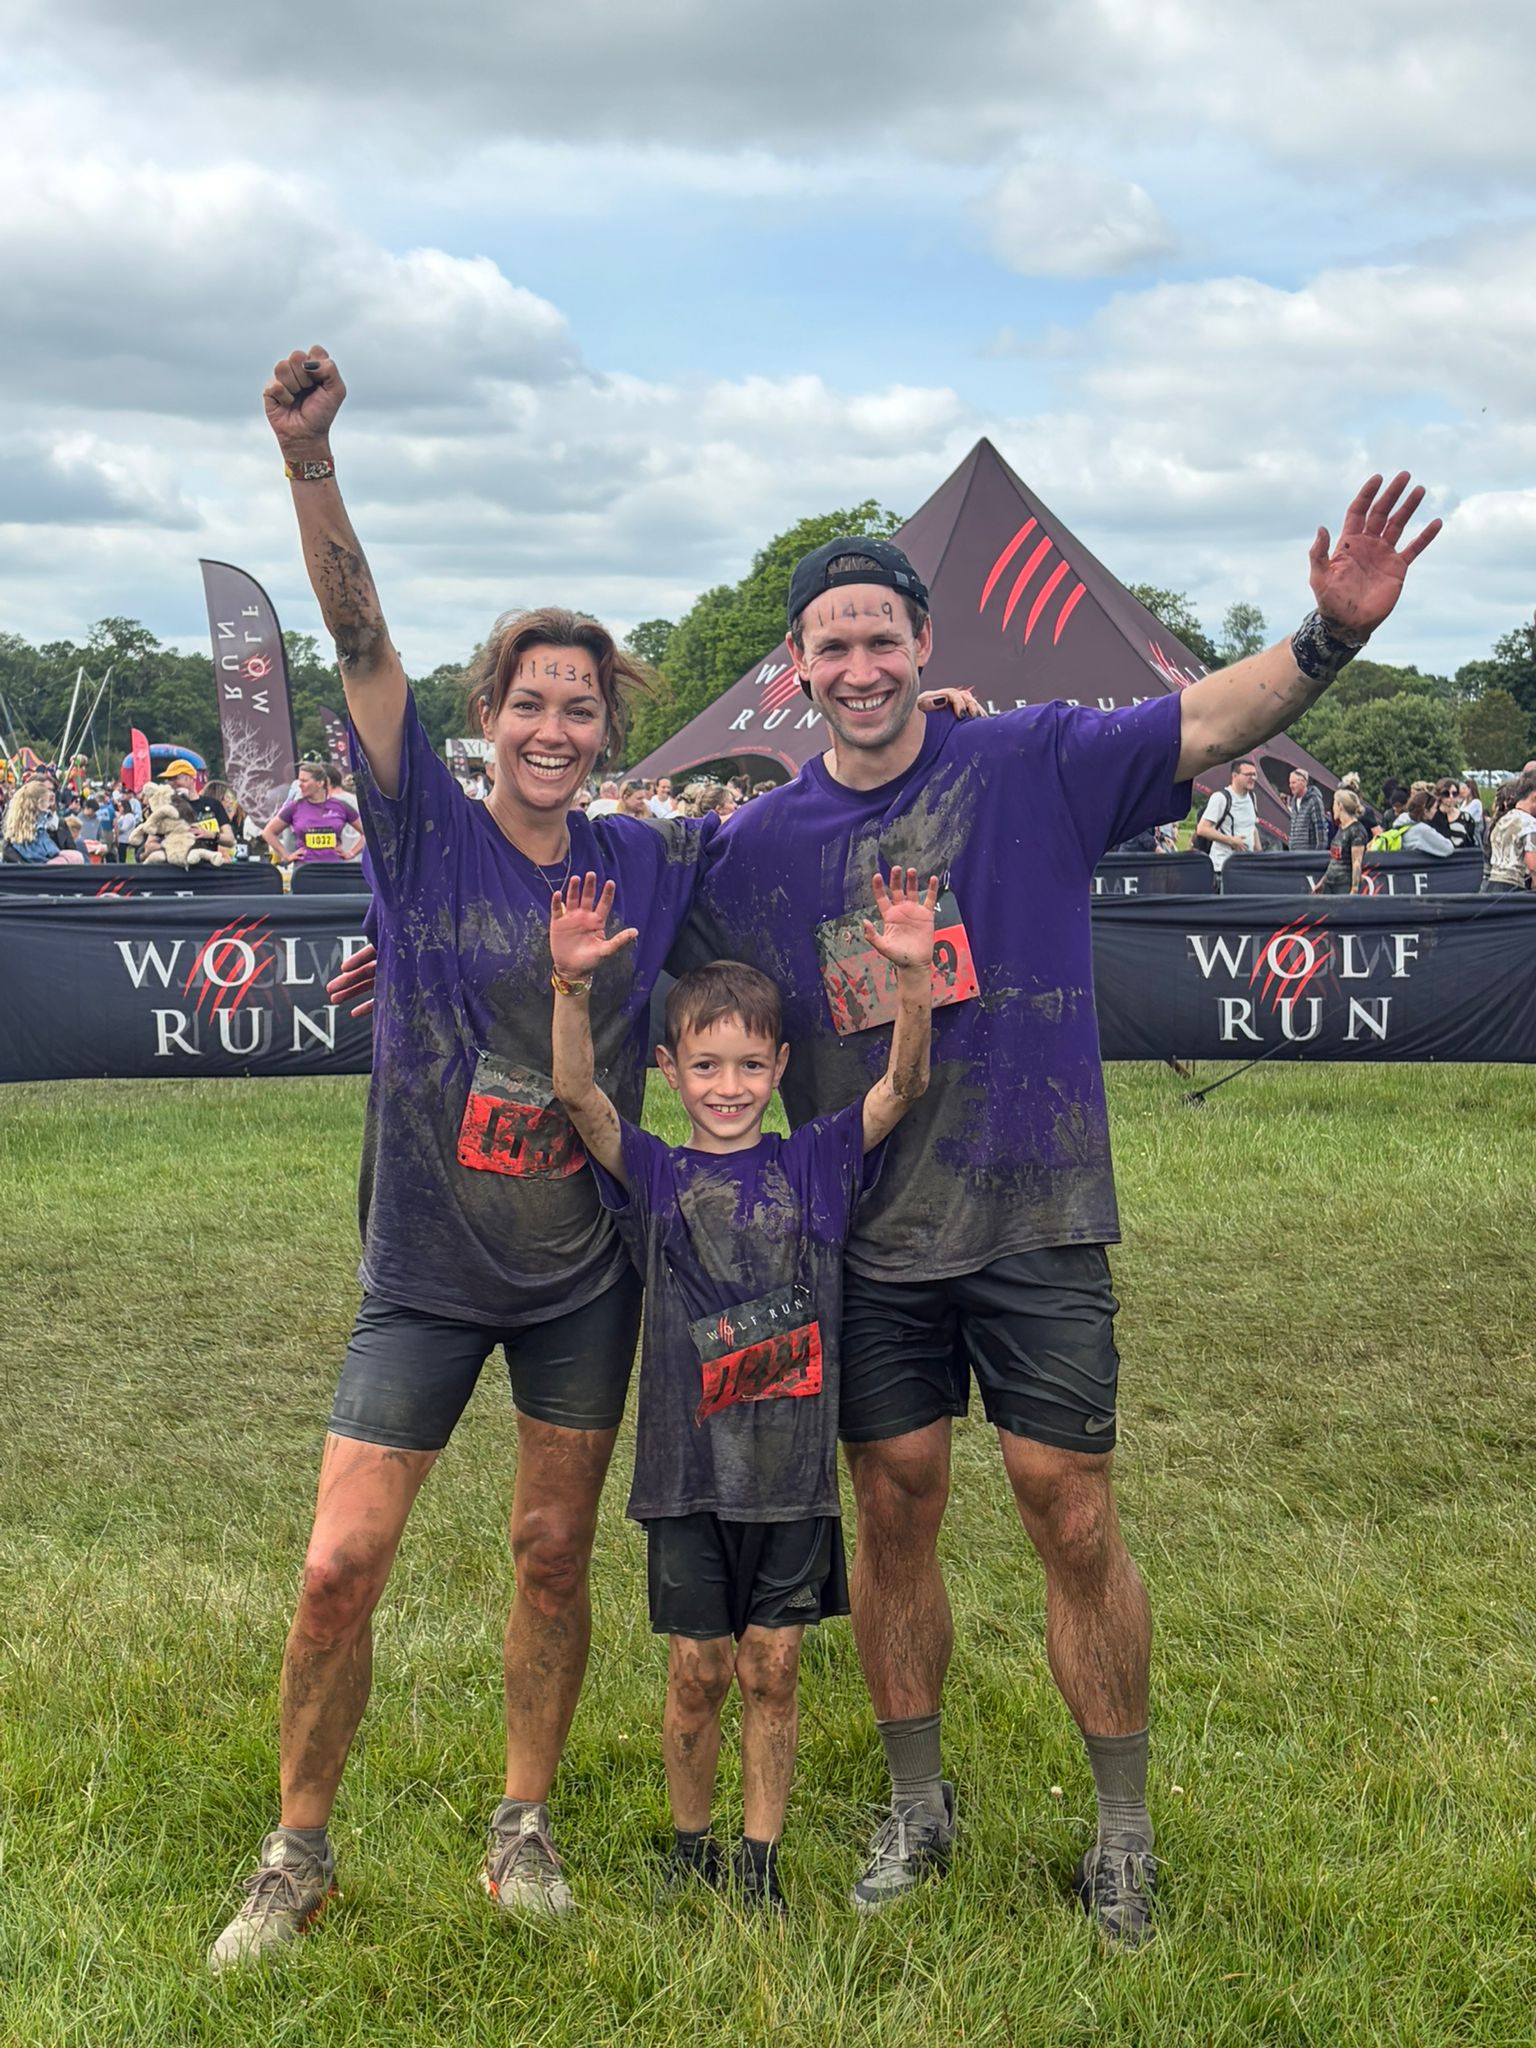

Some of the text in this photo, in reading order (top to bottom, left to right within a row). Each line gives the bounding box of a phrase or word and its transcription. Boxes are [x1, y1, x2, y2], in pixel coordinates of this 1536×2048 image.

[520, 660, 592, 690] 11434
[728, 708, 823, 730] RUN
[114, 935, 368, 989] WOLF
[1187, 933, 1419, 979] WOLF
[151, 1004, 339, 1057] RUN
[1219, 996, 1392, 1041] RUN
[707, 1298, 804, 1341] WOLF RUN
